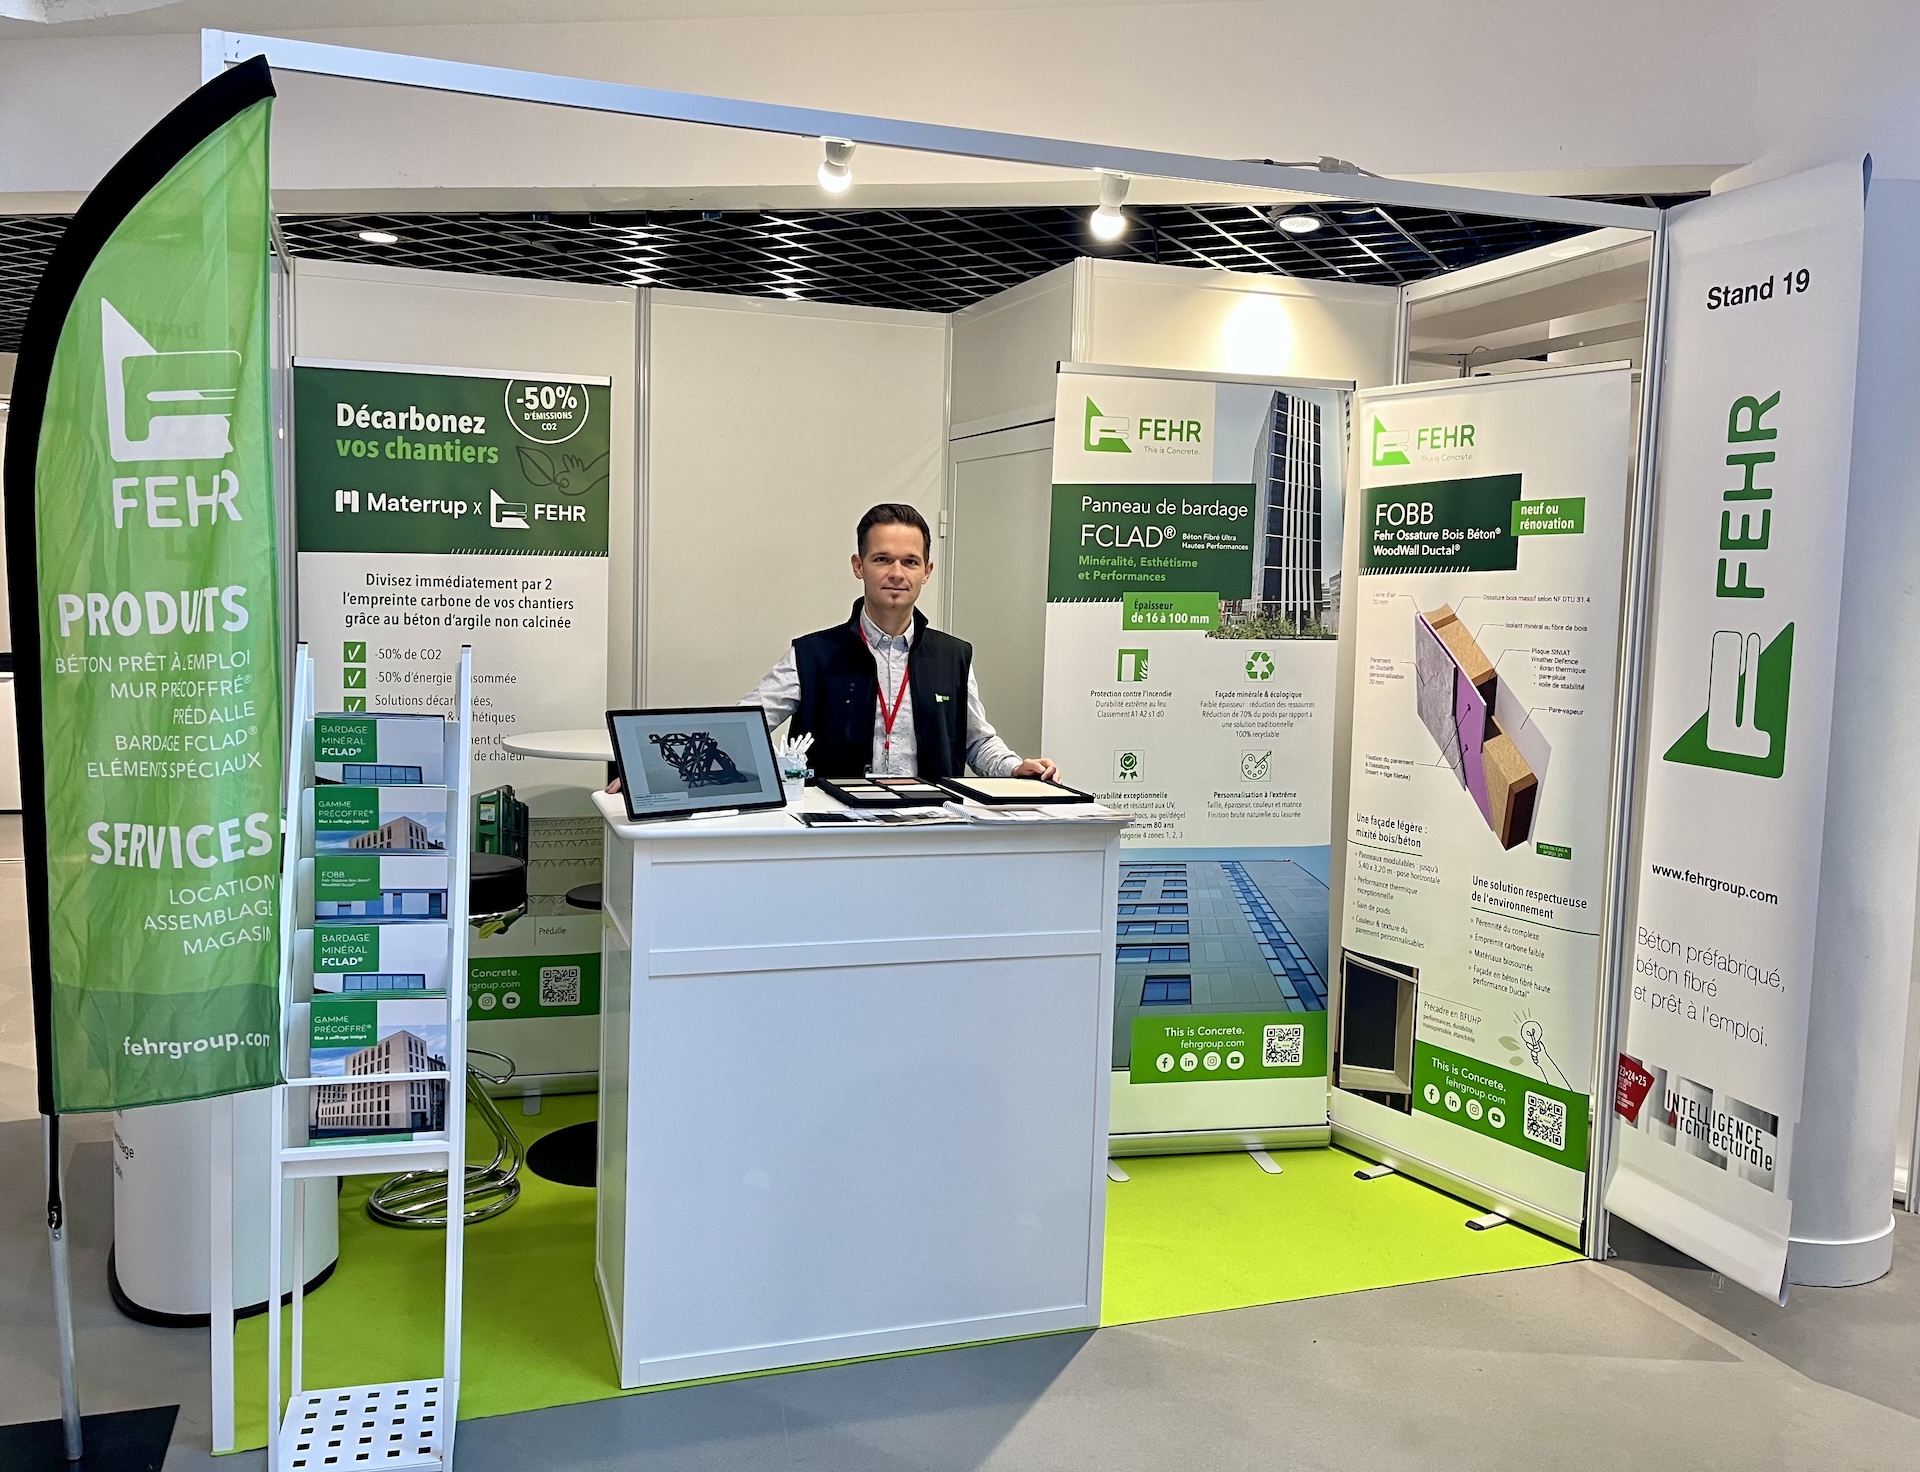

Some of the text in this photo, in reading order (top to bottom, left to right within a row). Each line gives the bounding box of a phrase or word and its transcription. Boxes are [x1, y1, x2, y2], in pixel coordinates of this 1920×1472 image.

[1706, 268, 1810, 311] Stand 19
[516, 385, 578, 410] -50%
[336, 402, 486, 435] Décarbonez
[524, 410, 573, 421] D'ÉMISSIONS
[541, 422, 557, 431] CO2
[1139, 418, 1202, 443] FEHR
[1417, 424, 1476, 450] FEHR
[336, 436, 499, 464] vos chantiers
[1144, 446, 1201, 456] This is Concrete.
[1421, 455, 1434, 463] This
[112, 469, 243, 529] FEHR
[1716, 390, 1782, 600] FEHR
[367, 492, 468, 519] Materrup
[534, 503, 587, 522] FEHR
[1082, 496, 1249, 521] Panneau de bardage
[1375, 502, 1434, 526] FOBB
[1520, 502, 1559, 516] neuf ou
[1519, 517, 1575, 531] rénovation
[1081, 524, 1176, 549] FCLAD®
[1182, 533, 1237, 542] Béton Fibré Ultra
[1373, 530, 1395, 542] Fehr
[1396, 529, 1440, 541] Ossature
[1442, 528, 1464, 540] Bois
[1182, 542, 1249, 551] Hautes Performances
[1373, 544, 1420, 557] WoodWall
[1078, 555, 1198, 569] Minéralité, Esthétisme
[365, 573, 553, 594] Divisez immédiatement par 2
[1078, 571, 1166, 583] et Performances
[342, 591, 574, 610] l'empreinte carbone de vos chantiers
[1133, 600, 1174, 613] Épaisseur
[345, 613, 572, 630] grâce au béton d'argile non calcinée
[1131, 612, 1210, 625] de 16 à 100 mm
[374, 648, 442, 661] -50% de CO2
[55, 654, 112, 674] BÉTON
[119, 652, 166, 672] PRÊT
[374, 671, 452, 687] -50% d'énergie
[110, 682, 157, 699] MUR
[1090, 690, 1122, 698] Protection
[1143, 690, 1172, 698] l'incendie
[1215, 690, 1236, 699] Façade
[1237, 690, 1263, 698] minérale
[1270, 690, 1303, 700] écologique
[374, 694, 423, 707] Solutions
[172, 701, 256, 725] PRÉDALLE
[321, 725, 368, 734] BARDAGE
[115, 735, 180, 752] BARDAGE
[321, 736, 366, 745] MINÉRAL
[474, 751, 486, 761] de
[1123, 792, 1168, 801] exceptionnelle
[1213, 791, 1263, 799] Personnalisation
[318, 800, 352, 809] GAMME
[1356, 812, 1423, 833] Une façade légère
[87, 812, 272, 869] SERVICES
[1355, 828, 1421, 848] mixité bois/béton
[1383, 857, 1415, 869] modulables
[321, 871, 345, 879] FOBB
[169, 874, 275, 905] LOCATION
[1472, 875, 1587, 909] Une solution respectueuse
[1651, 863, 1779, 905] www.fehrgroup.com
[1471, 890, 1554, 920] de l'environnement
[322, 933, 370, 943] BARDAGE
[539, 926, 567, 936] Prédalle
[321, 945, 367, 955] MINÉRAL
[1638, 926, 1785, 993] Béton préfabriqué,
[471, 968, 520, 978] Concrete.
[1636, 953, 1717, 998] béton fibré
[314, 1015, 349, 1024] GAMME
[1633, 984, 1768, 1047] et prêt à l'emploi.
[1165, 1025, 1245, 1037] This is Concrete.
[1180, 1038, 1245, 1051] fehrgroup.com
[1431, 1057, 1507, 1092] This is Concrete.
[1445, 1075, 1506, 1105] fehrgroup.com
[1666, 1088, 1763, 1150] INTELLIGENCE
[1667, 1107, 1773, 1172] Architecturale
